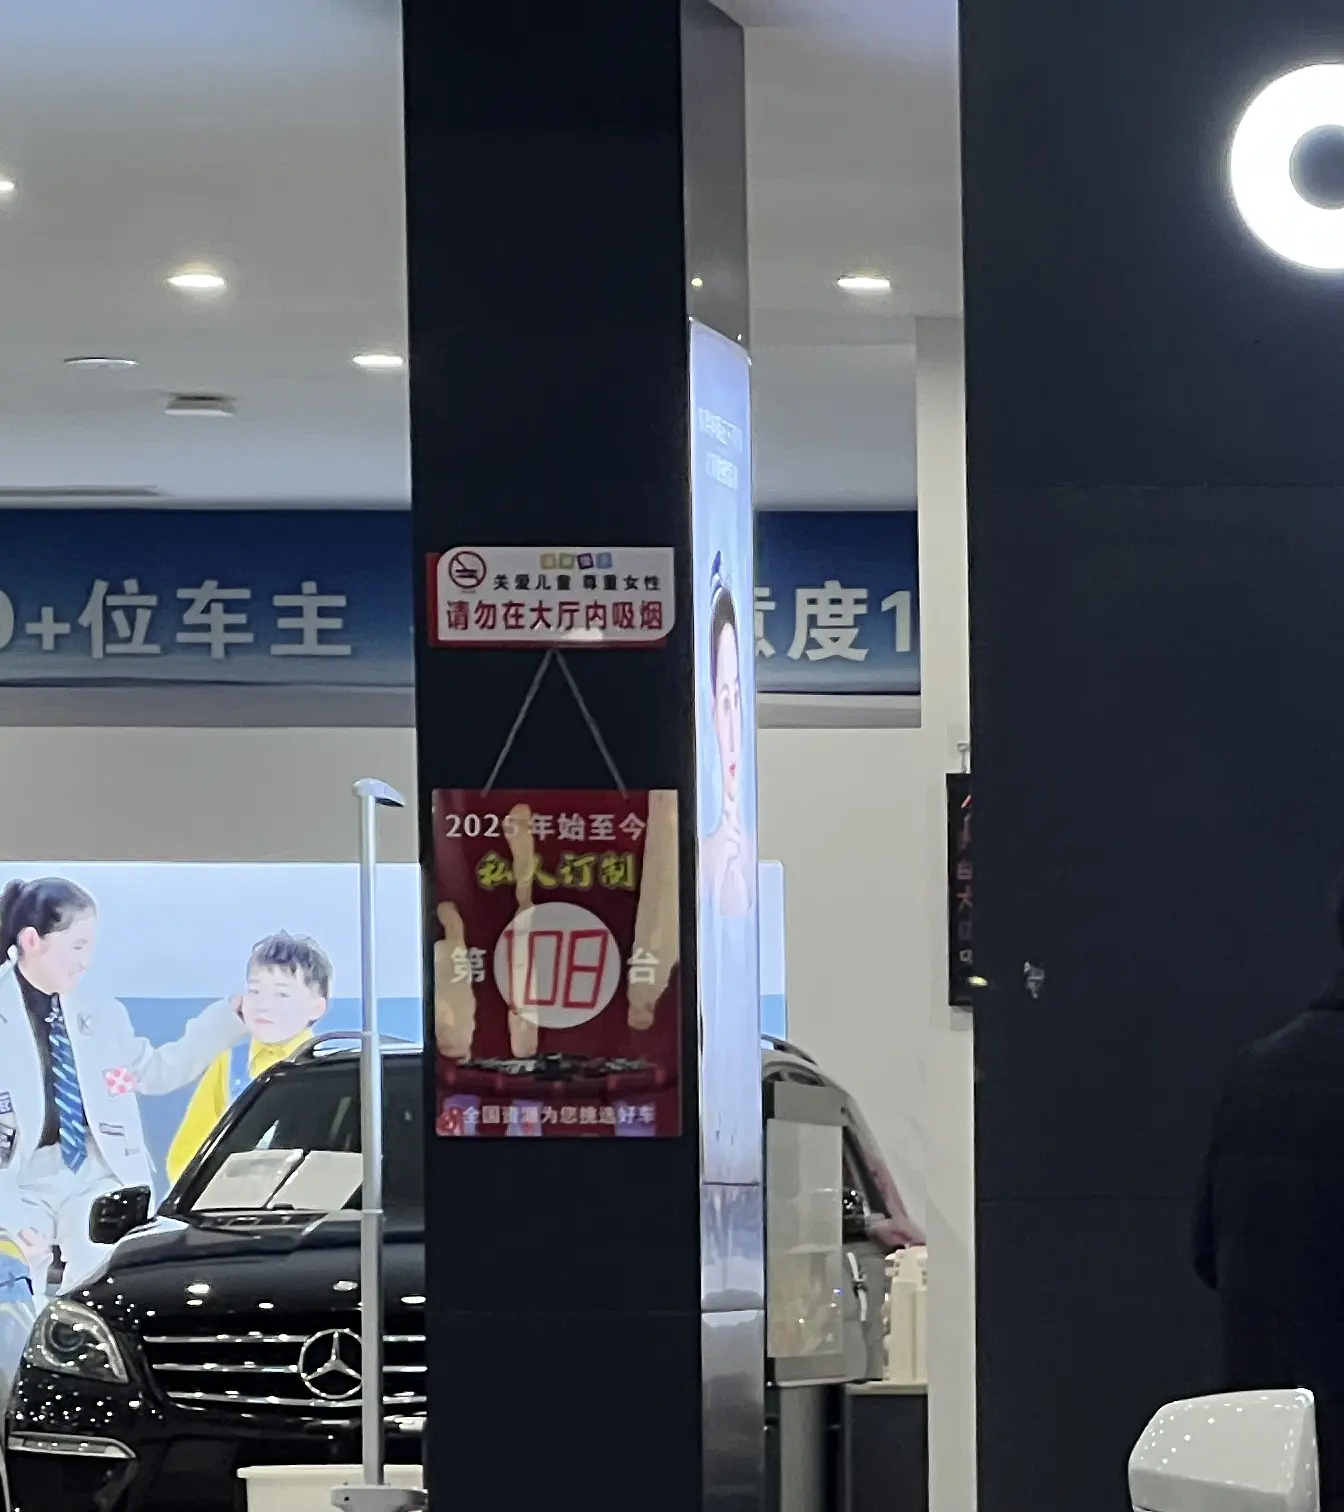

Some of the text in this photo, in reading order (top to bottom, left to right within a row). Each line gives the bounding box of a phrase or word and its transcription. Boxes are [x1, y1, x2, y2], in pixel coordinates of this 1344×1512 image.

[447, 600, 662, 631] 请勿在大厅内吸烟
[754, 580, 911, 661] 度1
[626, 947, 660, 985] 台
